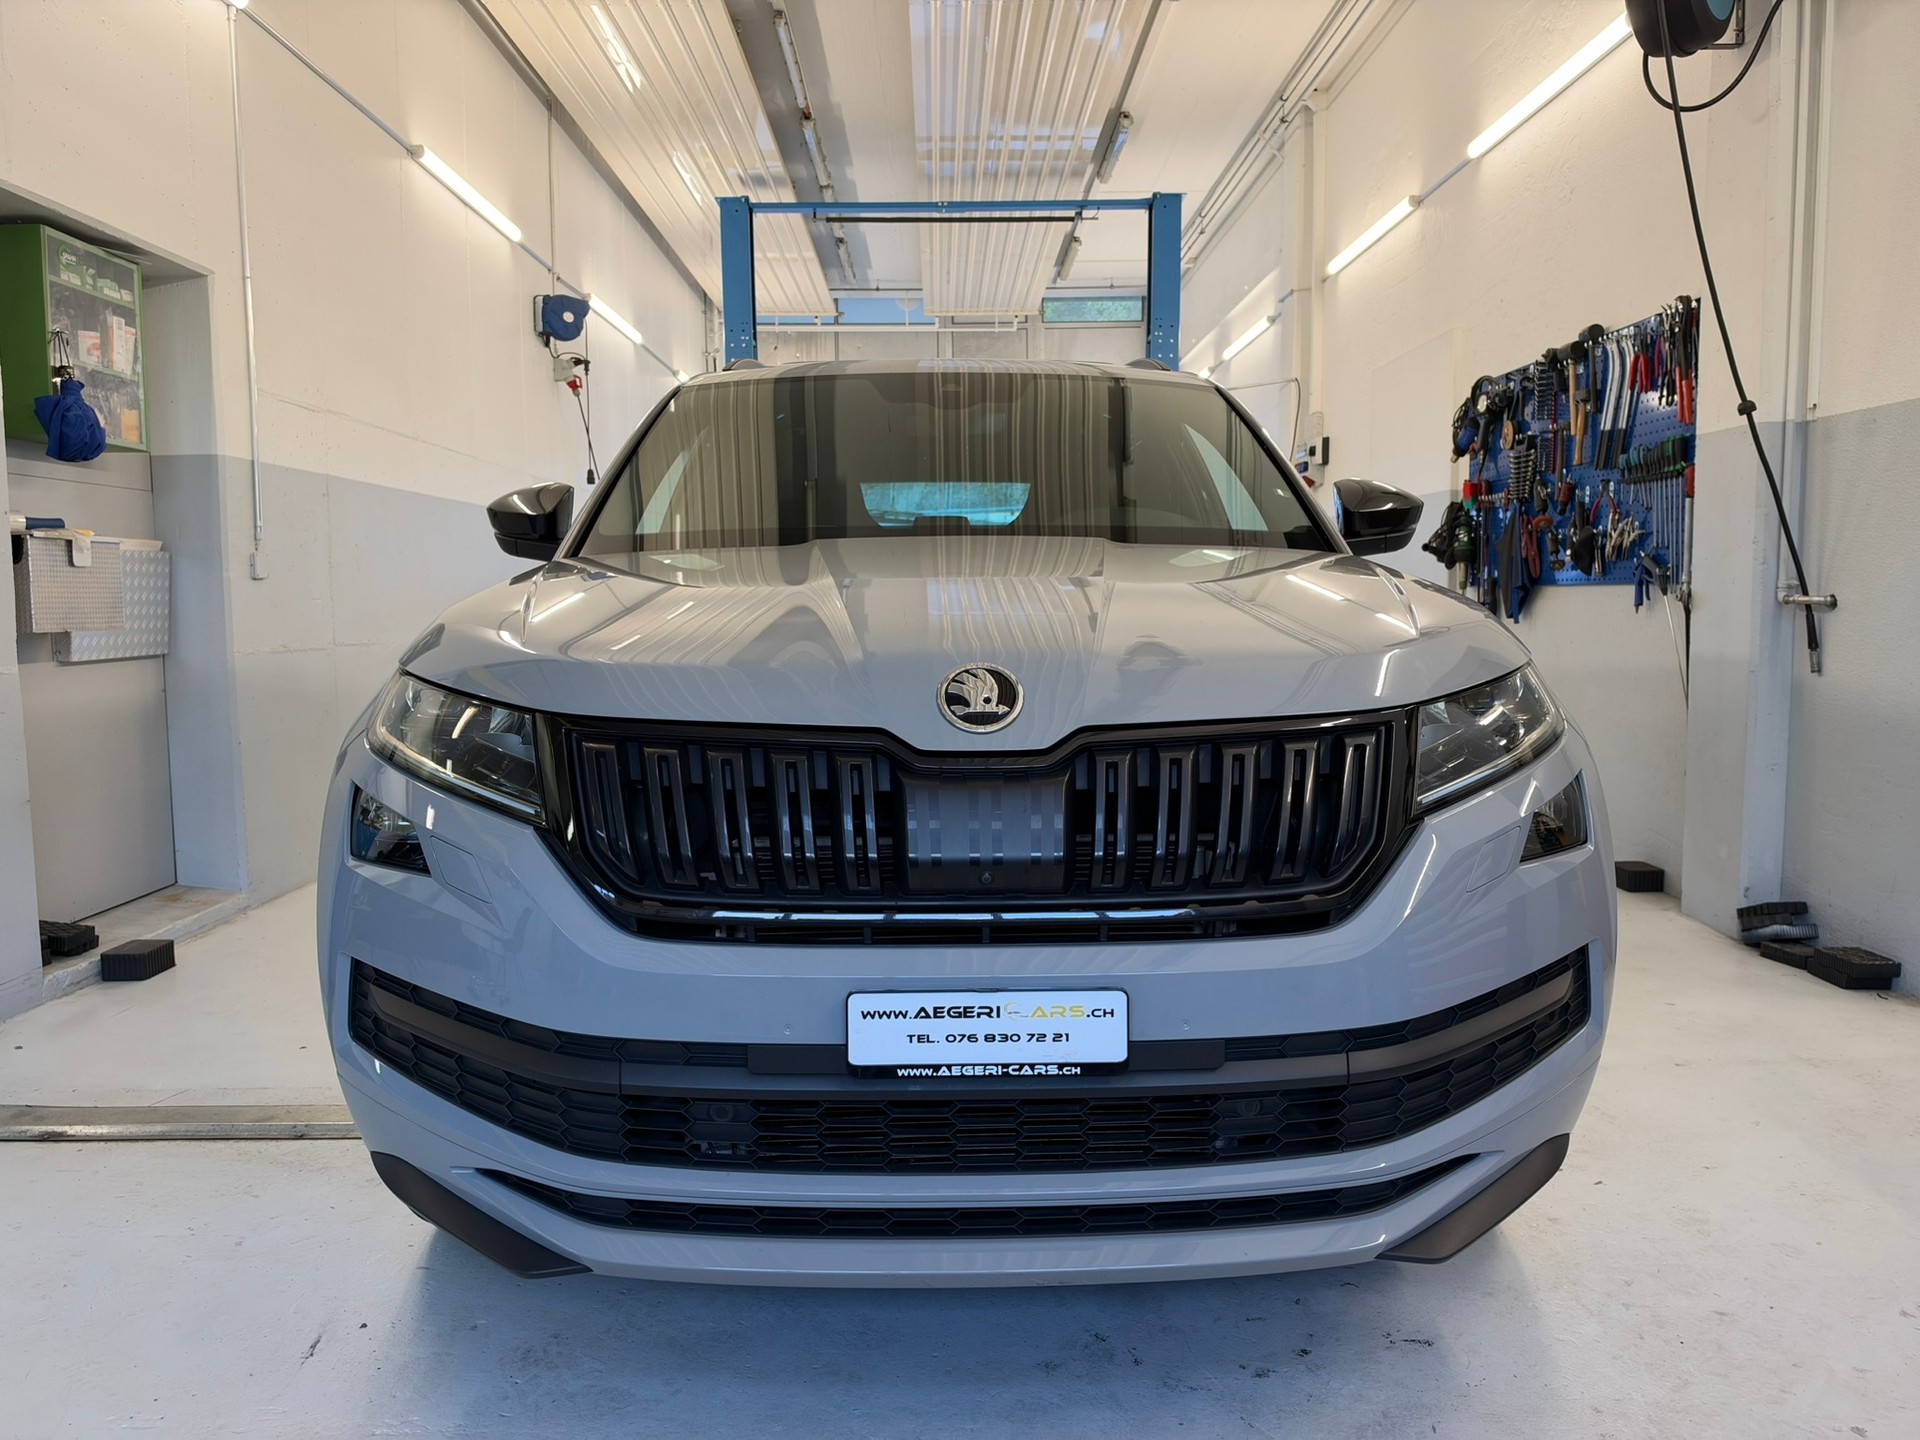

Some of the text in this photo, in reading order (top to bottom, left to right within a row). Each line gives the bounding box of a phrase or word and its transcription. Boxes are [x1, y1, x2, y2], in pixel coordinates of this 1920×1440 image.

[906, 1033, 1070, 1044] TEL. 076 830 72 21
[896, 1064, 1081, 1077] WWW.AEGERI-CARS.CH
